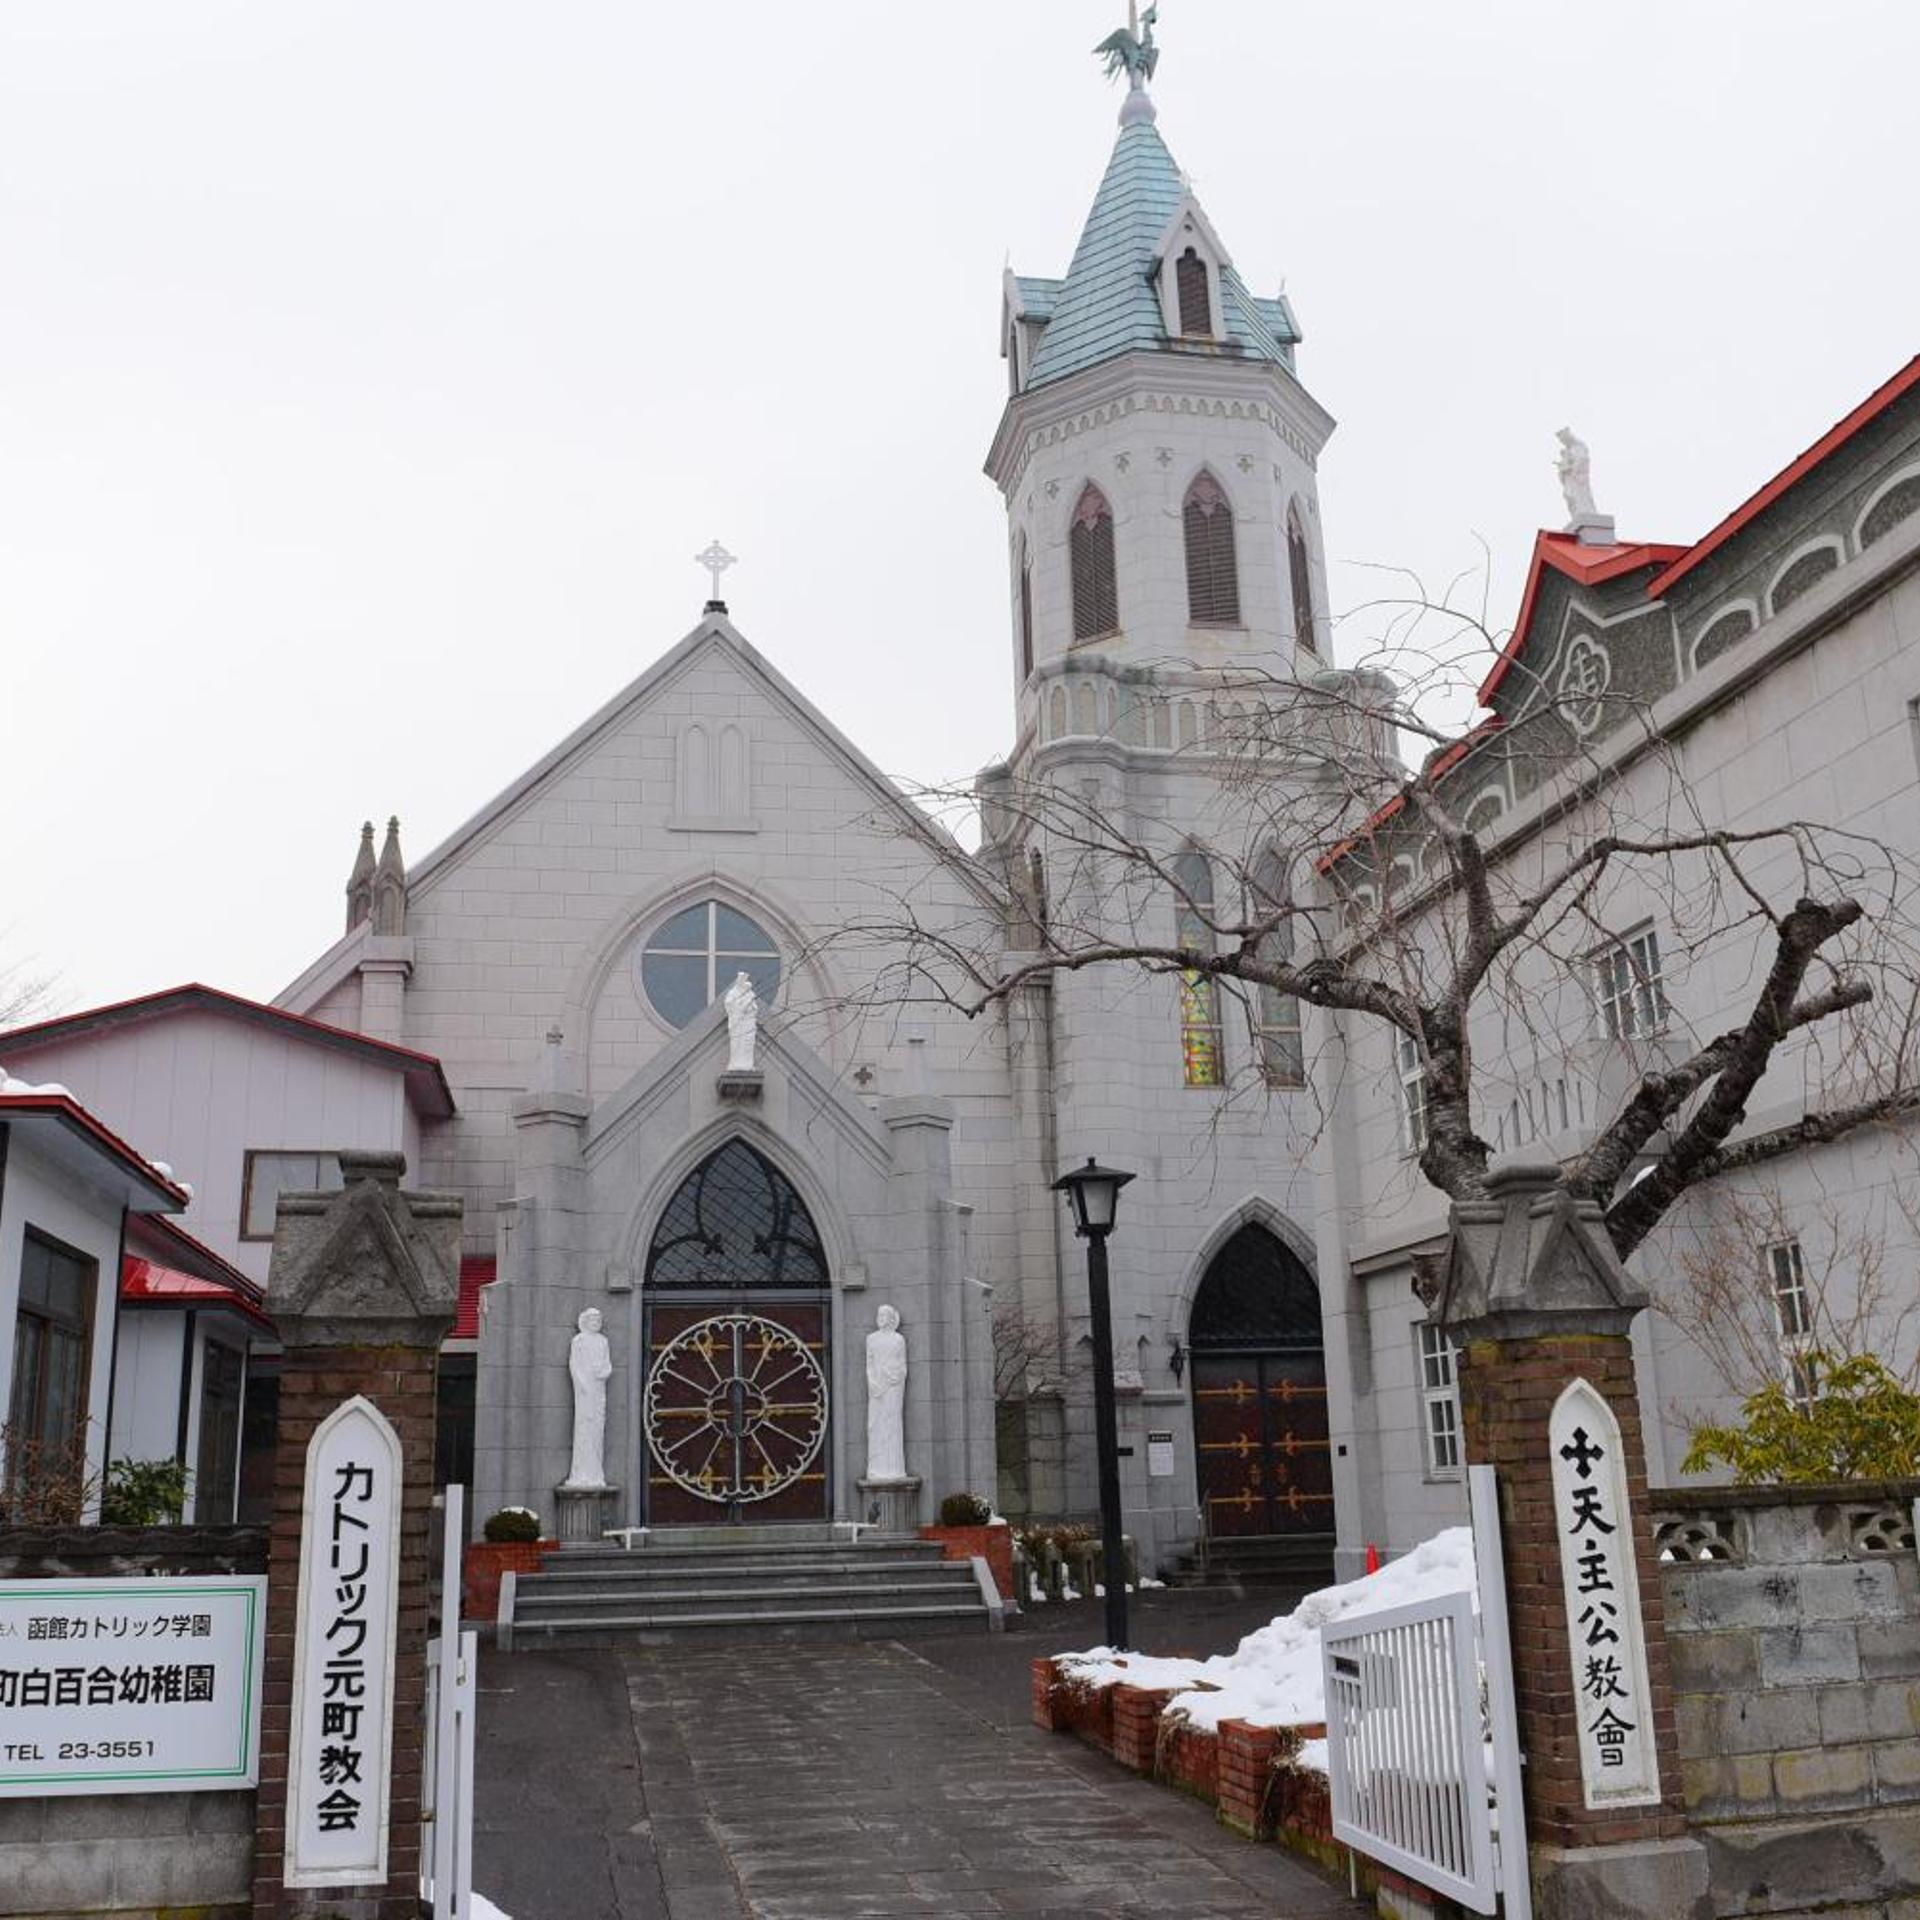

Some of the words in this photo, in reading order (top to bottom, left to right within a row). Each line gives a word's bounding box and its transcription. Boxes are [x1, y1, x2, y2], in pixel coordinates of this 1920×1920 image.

[28, 1615, 211, 1640] 函館カトリック学園
[317, 1462, 374, 1832] カトリック元町教会
[1569, 1486, 1636, 1766] 天主公教會
[5, 1744, 44, 1761] TEL
[58, 1741, 154, 1760] 23-3551
